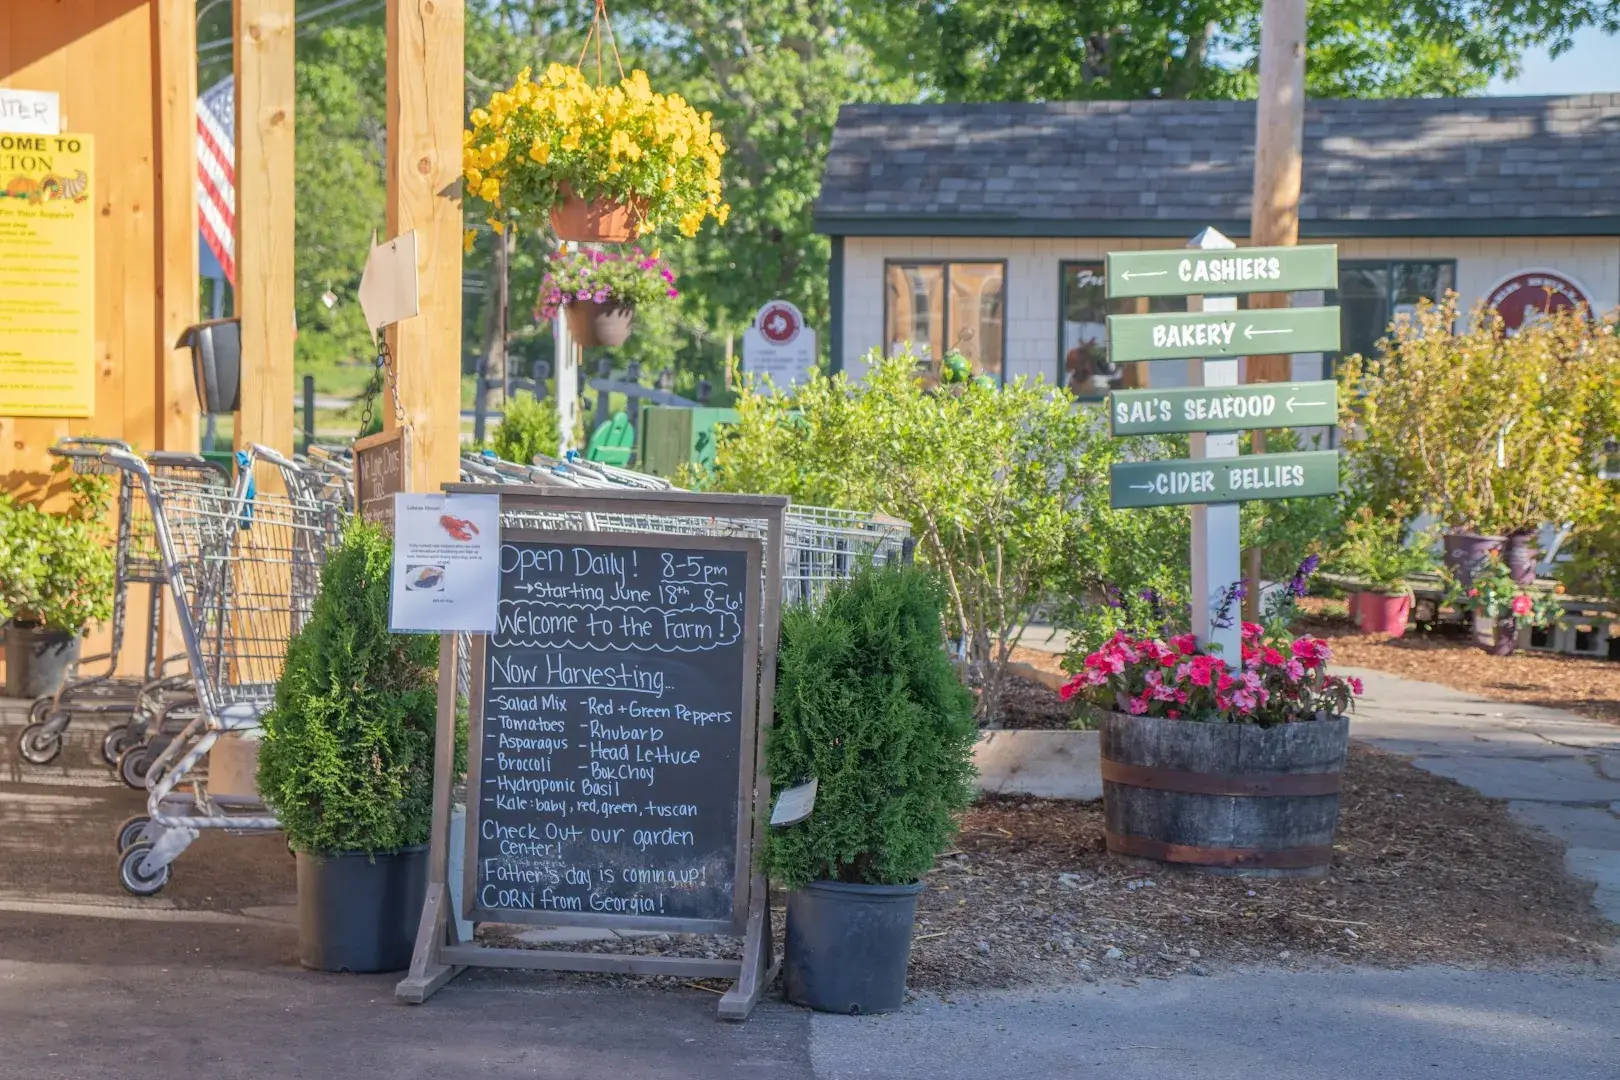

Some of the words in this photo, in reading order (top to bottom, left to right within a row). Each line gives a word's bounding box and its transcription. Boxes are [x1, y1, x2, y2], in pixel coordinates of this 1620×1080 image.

[54, 139, 81, 153] TO
[1178, 257, 1280, 283] CASHIERS
[1153, 322, 1236, 347] BAKERY
[1116, 398, 1172, 424] SAL'S
[1184, 394, 1275, 419] SEAFOOD
[1156, 470, 1216, 494] CIDER
[1229, 465, 1305, 489] BELLIES
[500, 544, 563, 580] Open
[534, 581, 605, 606] Starting
[610, 581, 652, 602] June
[498, 608, 578, 637] Welcome
[586, 613, 614, 638] to
[619, 614, 653, 638] the
[491, 655, 537, 684] Now
[542, 696, 567, 712] Mix
[676, 704, 732, 726] Peppers
[636, 745, 701, 765] Lettuce
[582, 779, 620, 797] Basil
[644, 799, 698, 817] tuscan
[482, 819, 540, 841] Check
[545, 821, 583, 842] Out
[590, 828, 625, 844] our
[633, 827, 695, 852] garden
[484, 858, 560, 884] Father's
[565, 866, 592, 891] day
[599, 864, 615, 884] is
[622, 865, 677, 889] coming
[481, 884, 536, 909] CORN
[540, 888, 582, 911] from
